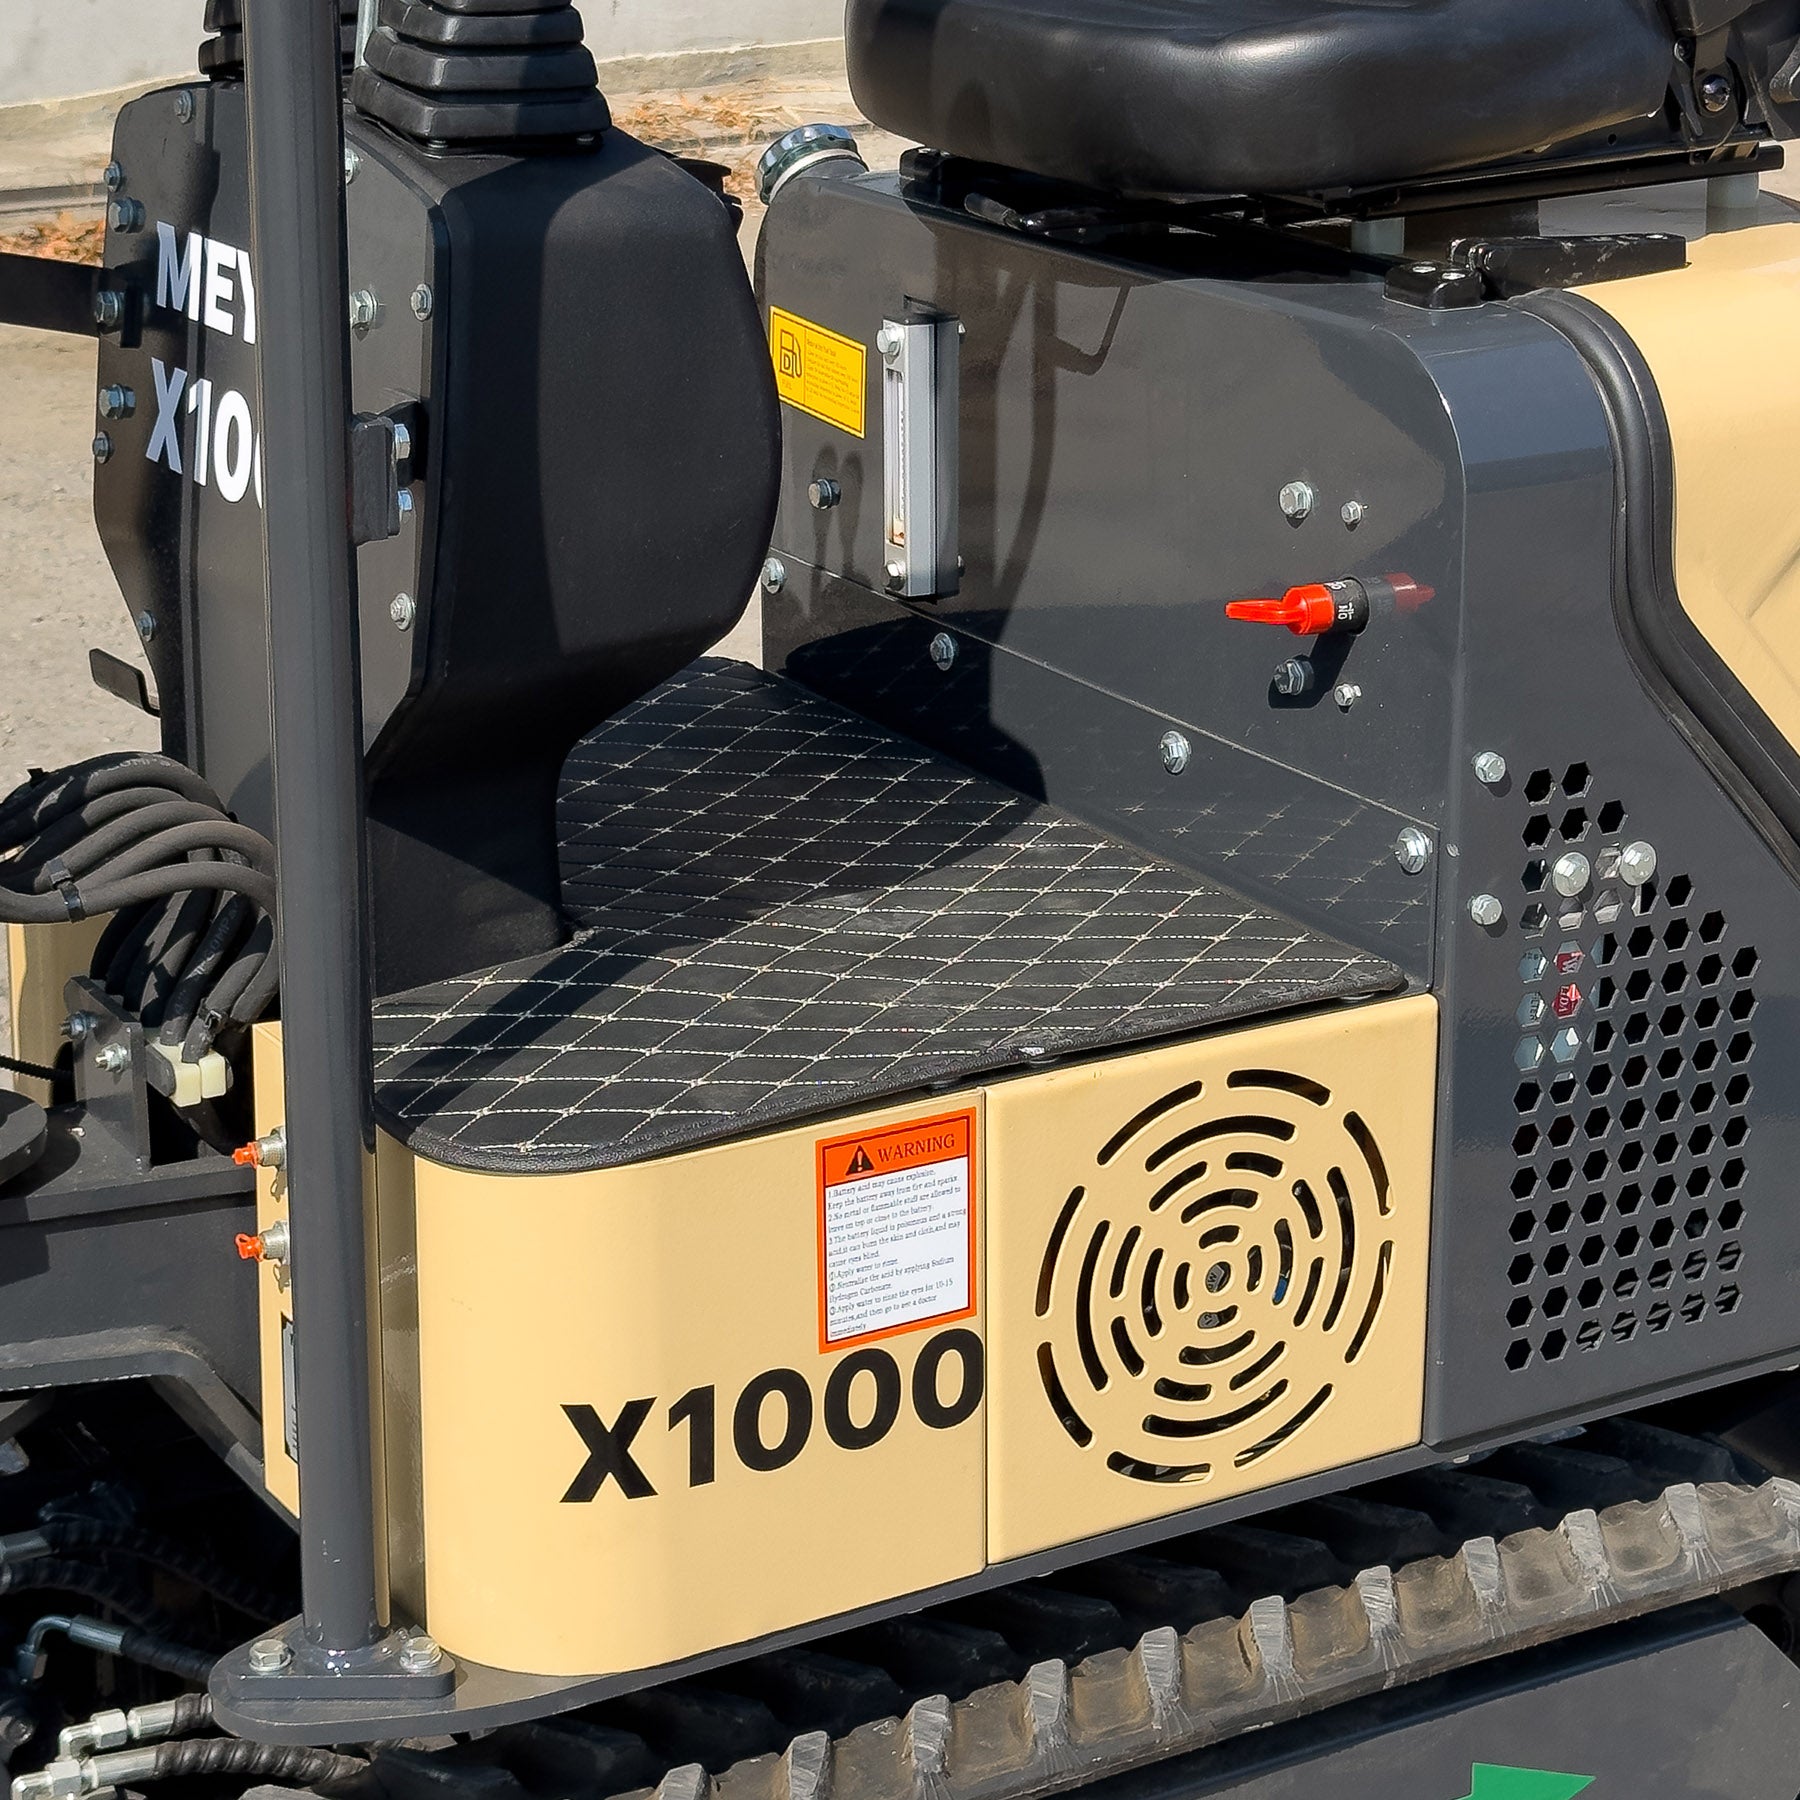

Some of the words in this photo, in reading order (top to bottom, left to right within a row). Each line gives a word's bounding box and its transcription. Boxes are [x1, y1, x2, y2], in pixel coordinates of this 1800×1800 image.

[146, 357, 263, 509] X10
[878, 1133, 956, 1163] WARNING
[845, 1197, 854, 1206] the
[879, 1236, 888, 1244] the
[870, 1273, 878, 1281] the
[900, 1289, 909, 1297] the
[560, 1328, 984, 1503] X1000
